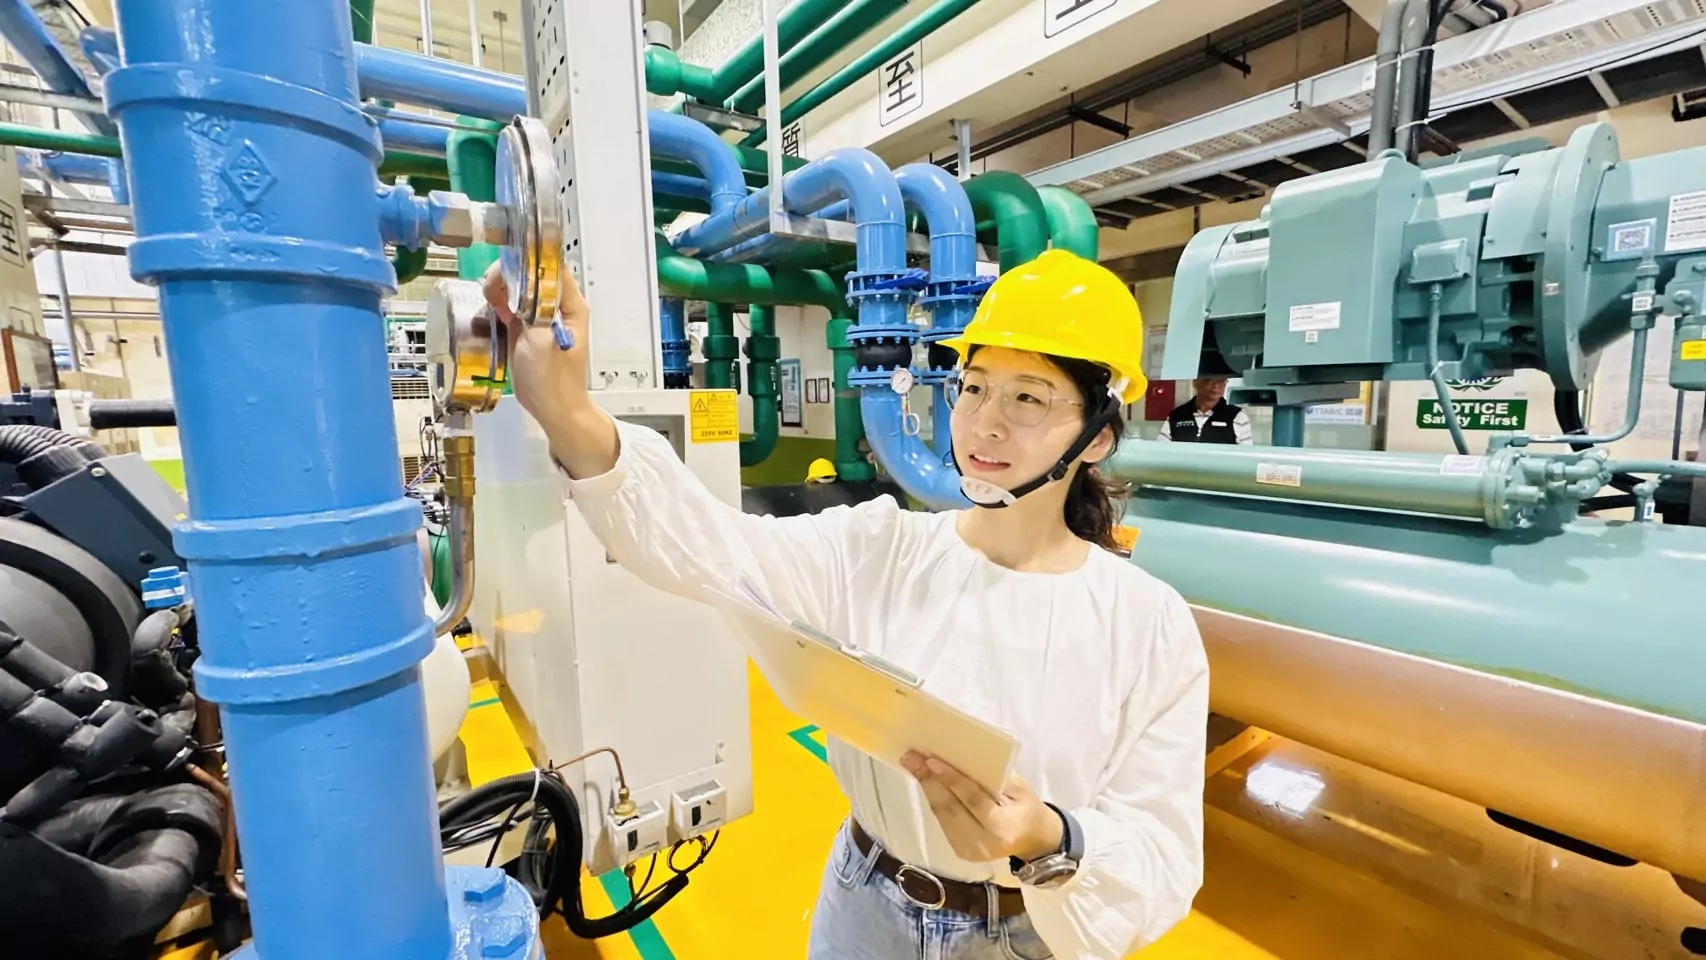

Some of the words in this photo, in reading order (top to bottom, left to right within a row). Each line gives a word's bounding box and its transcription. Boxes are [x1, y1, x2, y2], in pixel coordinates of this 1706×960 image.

[885, 50, 917, 113] 至
[1422, 413, 1471, 427] Safty
[1480, 415, 1519, 426] First
